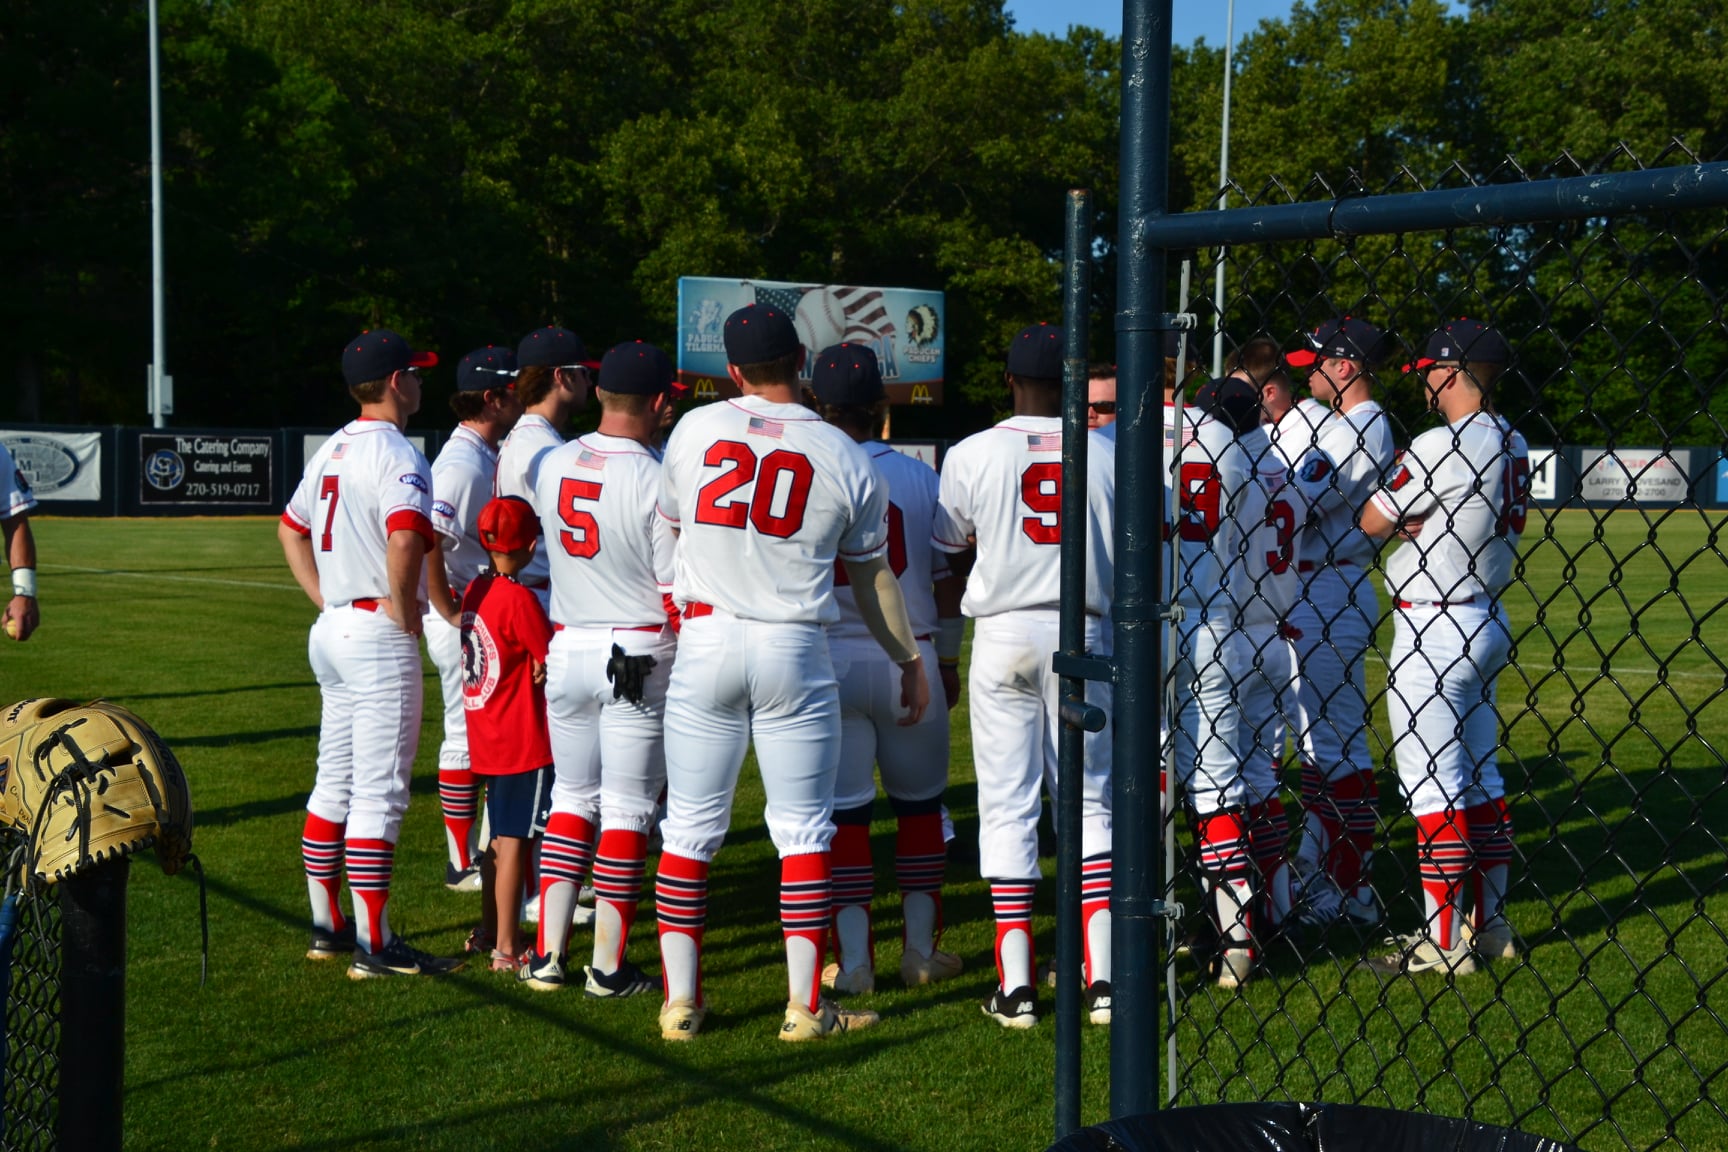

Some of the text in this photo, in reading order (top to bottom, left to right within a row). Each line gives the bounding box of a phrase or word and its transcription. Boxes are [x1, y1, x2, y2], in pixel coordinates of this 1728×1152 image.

[685, 342, 727, 353] TILGHMA
[687, 333, 724, 343] PADUCA
[175, 437, 269, 458] The Catering Company
[194, 460, 252, 474] Catering and Events
[1588, 477, 1621, 486] LARRY
[186, 483, 260, 496] 270-519-0717
[695, 439, 815, 539] 20
[1020, 461, 1061, 545] 9
[320, 475, 340, 552] 7
[557, 477, 604, 560] 5
[1265, 499, 1295, 576] 3
[475, 619, 497, 660] CHIEFS
